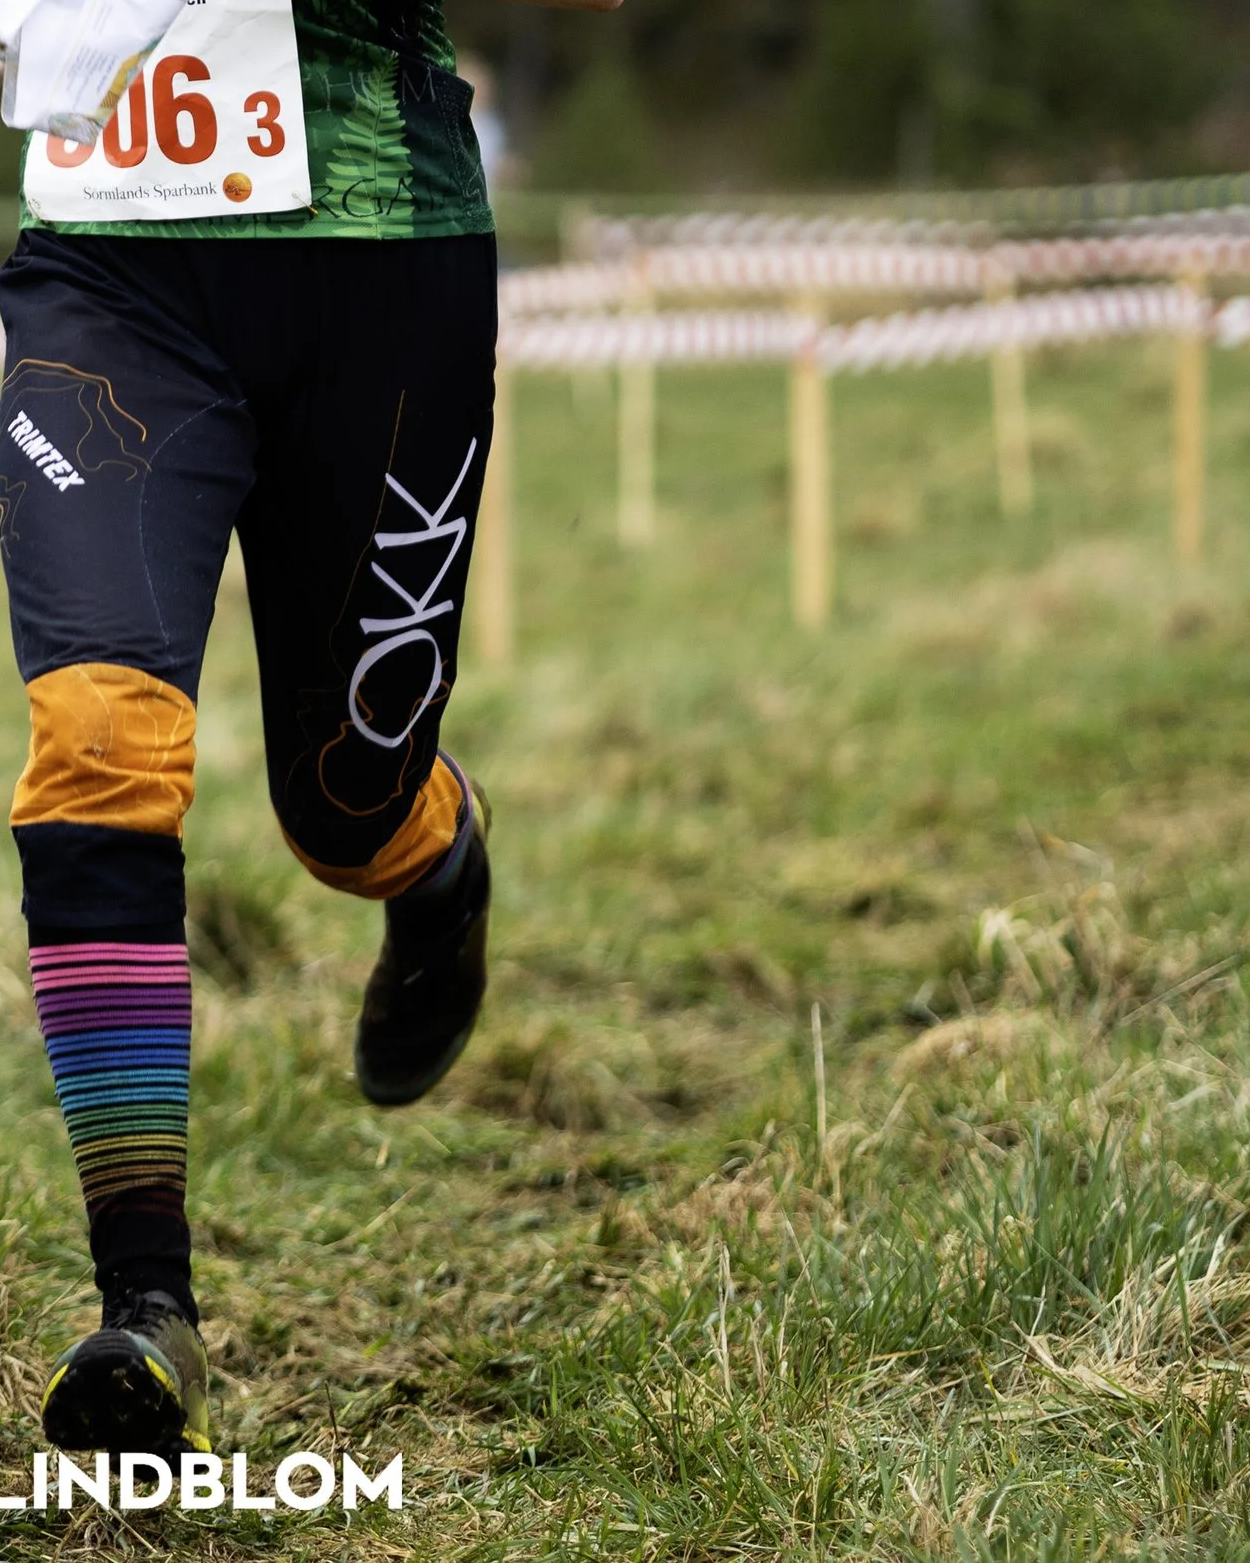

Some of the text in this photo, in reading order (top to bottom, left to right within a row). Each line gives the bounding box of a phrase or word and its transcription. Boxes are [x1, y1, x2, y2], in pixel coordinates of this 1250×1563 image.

[46, 54, 218, 169] 06
[243, 90, 286, 157] 3
[153, 182, 218, 201] Sparbank
[7, 410, 85, 492] TRIMTEX
[349, 437, 477, 748] OKK
